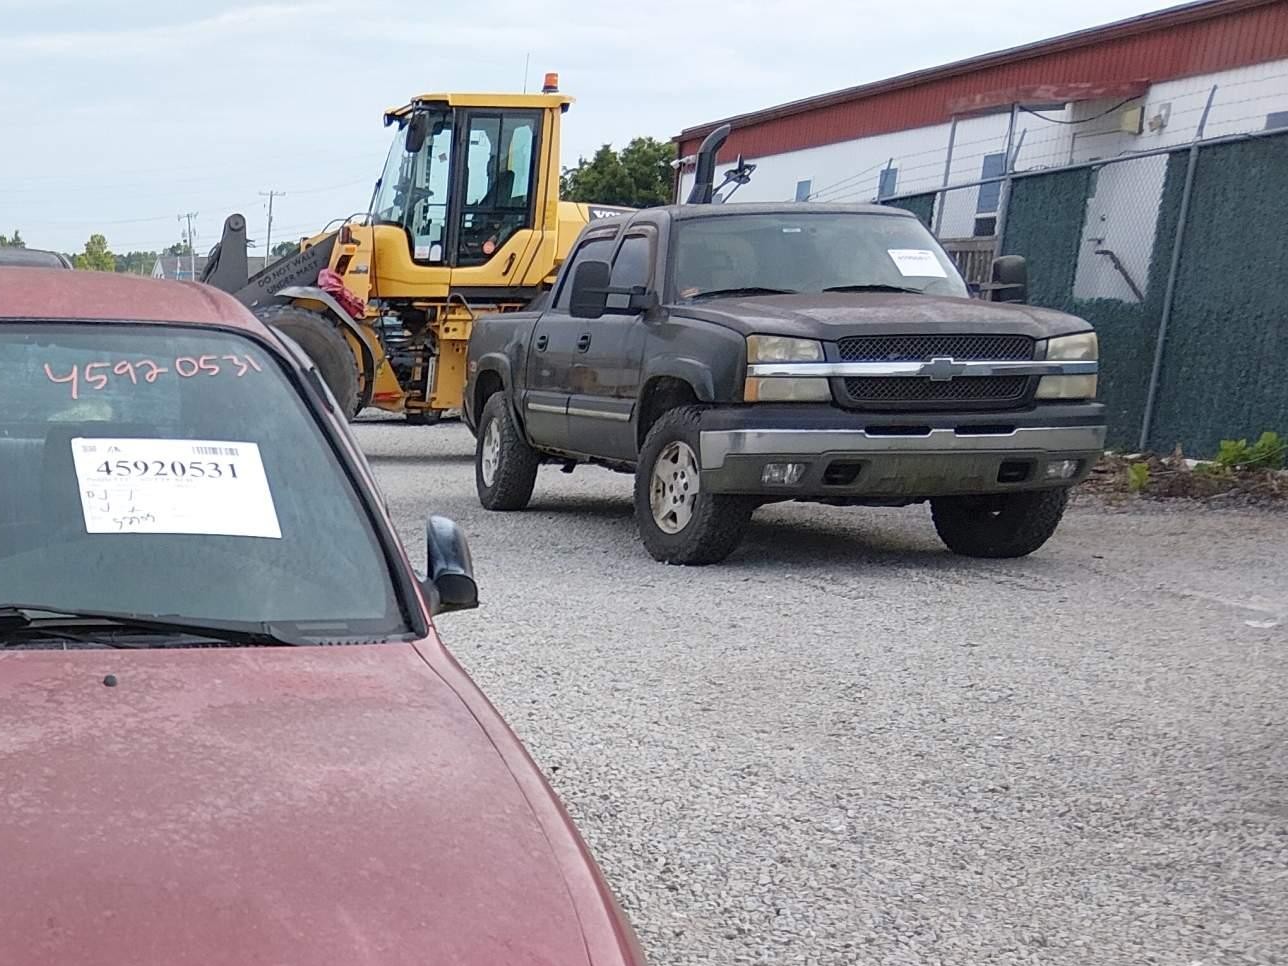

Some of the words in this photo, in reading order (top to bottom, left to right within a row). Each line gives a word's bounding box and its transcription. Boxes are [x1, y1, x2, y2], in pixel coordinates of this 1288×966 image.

[258, 276, 271, 288] DO
[272, 265, 290, 279] NOT
[44, 354, 262, 400] 45920531
[96, 459, 239, 479] 45920531
